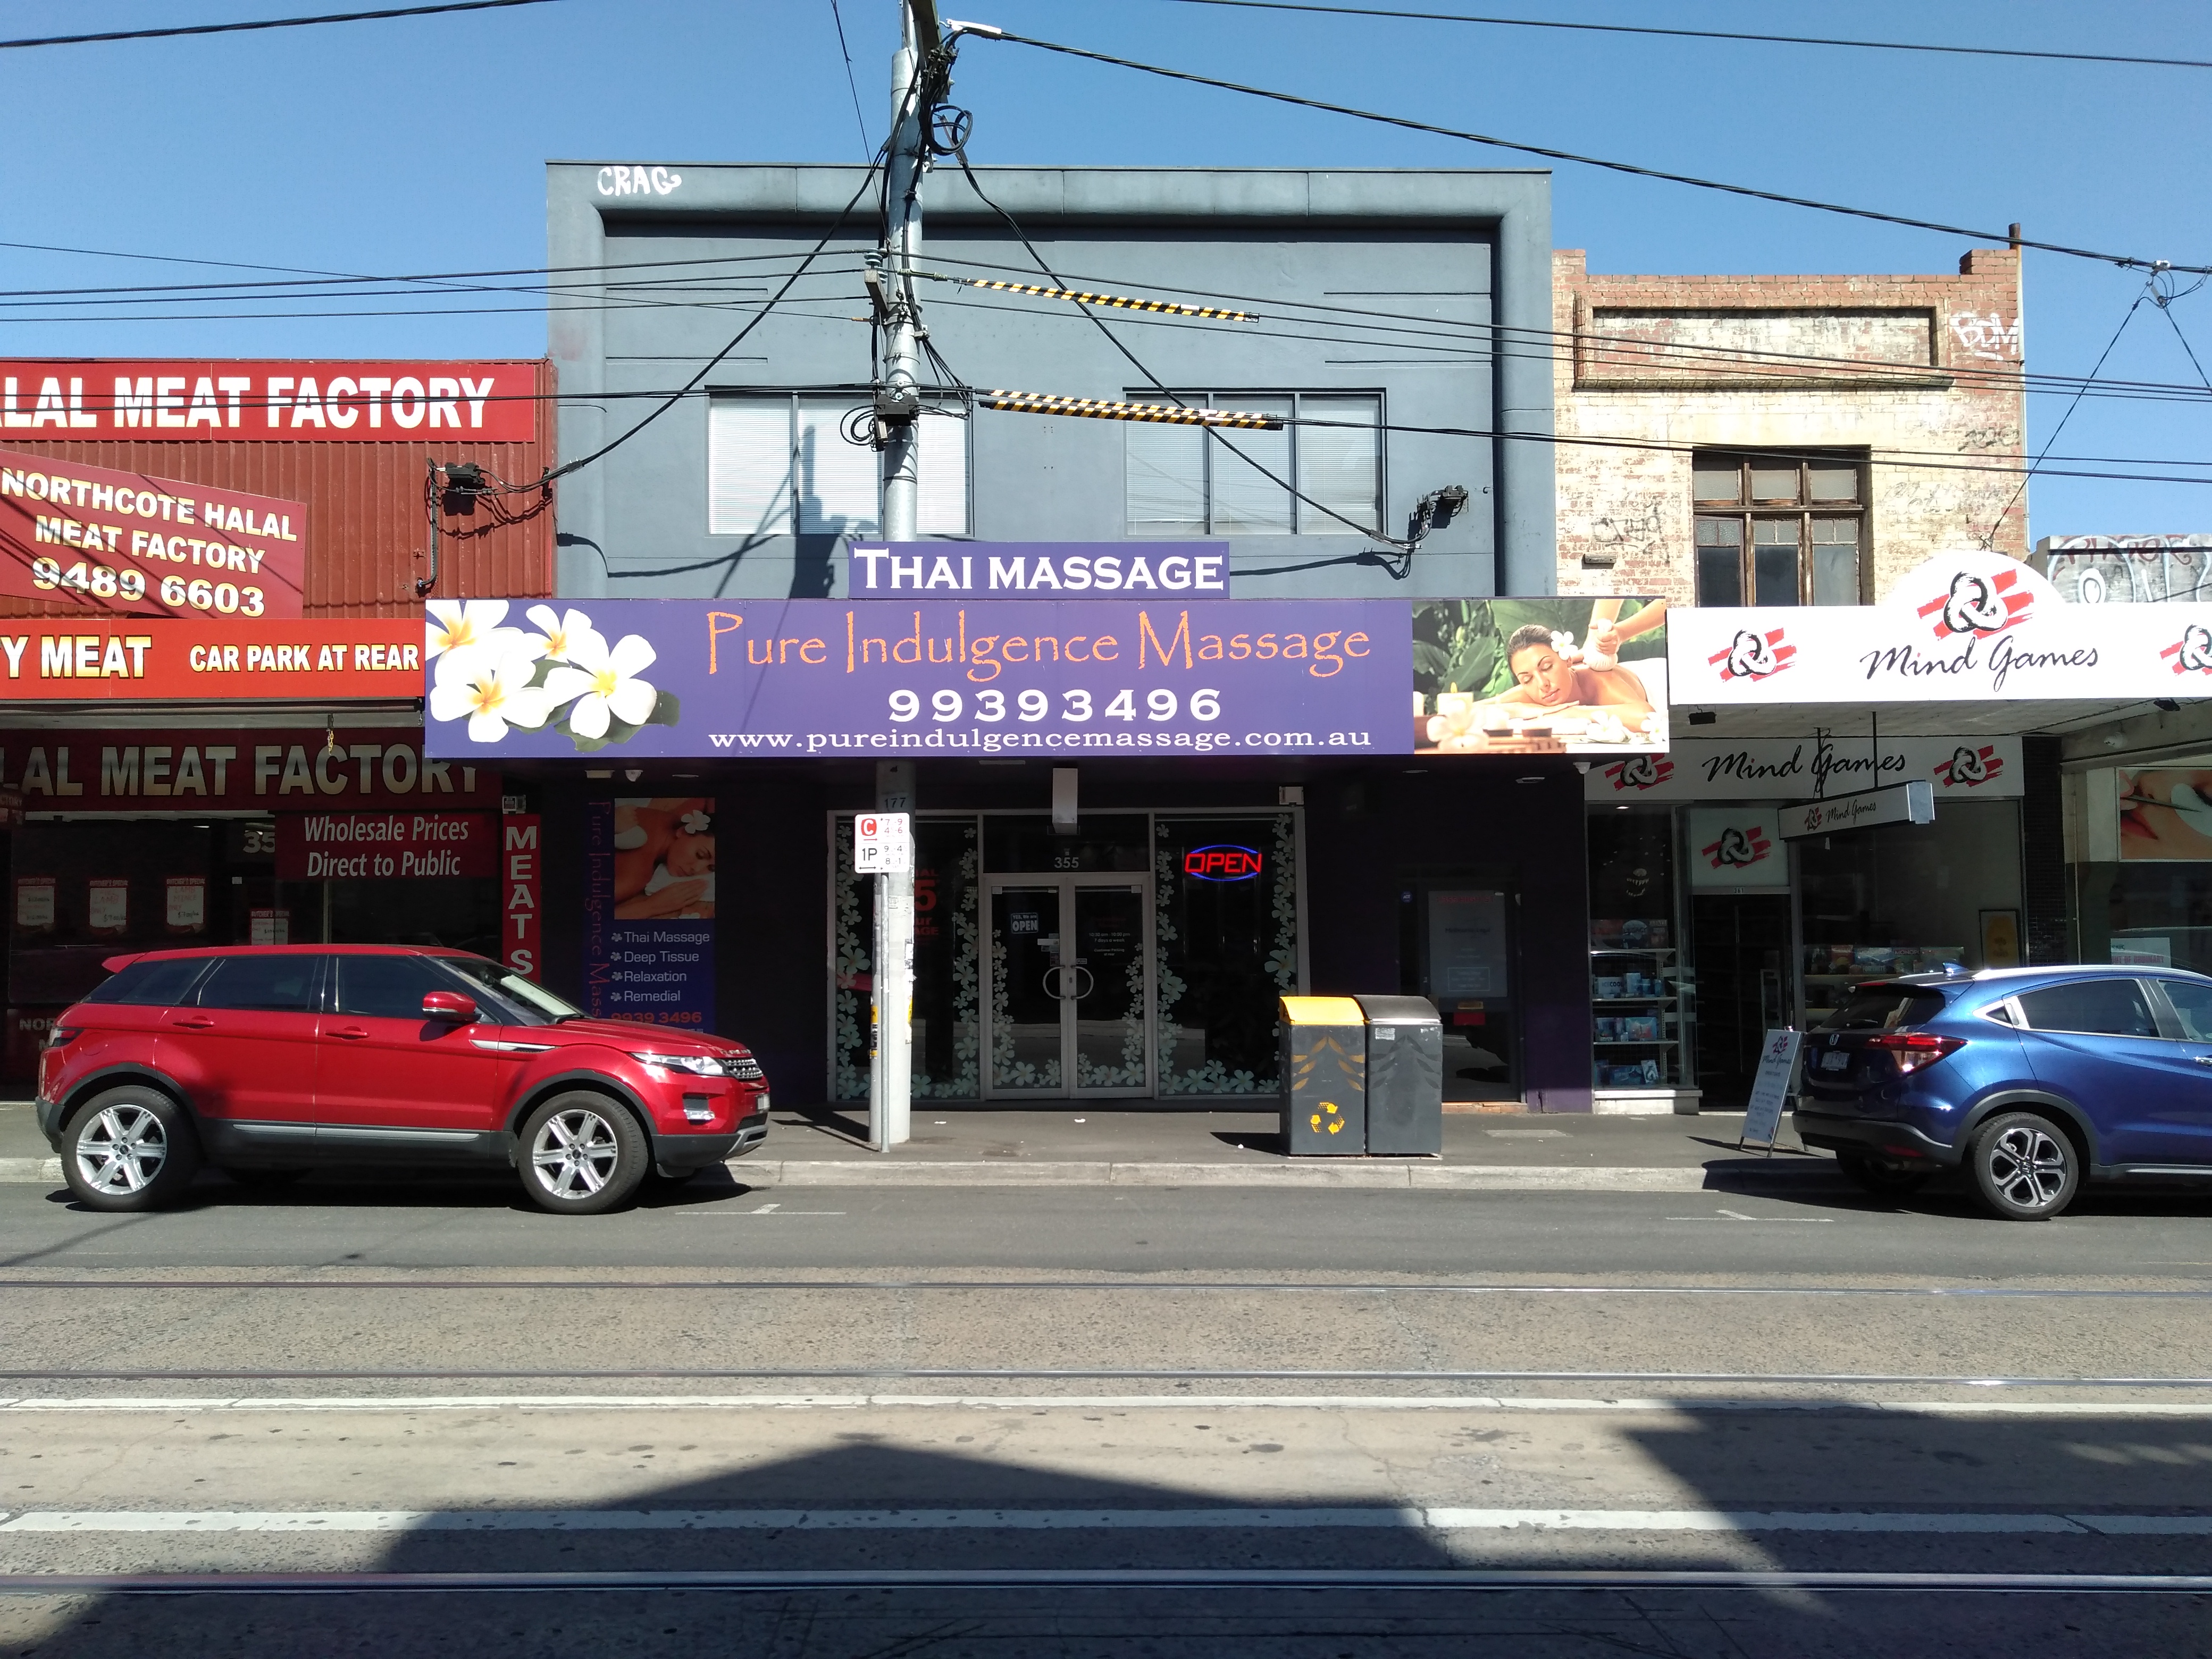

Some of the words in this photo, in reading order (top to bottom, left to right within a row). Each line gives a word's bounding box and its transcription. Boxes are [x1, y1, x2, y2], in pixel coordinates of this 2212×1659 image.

[114, 376, 250, 428] MEAT
[267, 376, 495, 429] FACTORY
[2, 467, 195, 525] NORTHCOTE
[205, 502, 297, 542] HALAL
[36, 514, 123, 553] MEAT
[132, 531, 265, 574] FACTORY
[854, 547, 974, 590] THAI
[987, 555, 1224, 590] MASSAGE
[32, 557, 146, 601] 9489
[161, 576, 265, 617] 6603
[41, 636, 152, 678] MEAT
[190, 645, 240, 672] CAR
[247, 645, 312, 672] PARK
[317, 644, 348, 671] AT
[355, 644, 420, 671] REAR
[708, 611, 826, 674] Pure
[847, 610, 1118, 682] Indulgence
[1138, 610, 1370, 677] Massage
[1860, 636, 1976, 680] Mind
[1989, 635, 2098, 692] Games
[889, 689, 1221, 722] 99393496
[708, 728, 1371, 752] www.pureindulgencemassage.com.au
[100, 746, 237, 796] MEAT
[1701, 744, 1804, 782] Mind
[1811, 743, 1906, 793] Games
[588, 802, 611, 846] Pure
[1825, 801, 1850, 823] Mind
[1851, 799, 1876, 825] Games
[305, 816, 405, 841] Wholesale
[412, 814, 468, 841] Prices
[307, 851, 367, 877] Direct
[374, 854, 394, 876] to
[402, 850, 460, 876] Public
[862, 848, 877, 861] 1P
[1054, 857, 1079, 869] 355
[1185, 853, 1262, 873] OPEN
[585, 852, 611, 956] Indulgence
[624, 931, 649, 943] Thai
[653, 931, 710, 945] Massage
[1012, 920, 1037, 932] OPEN
[624, 951, 656, 965] Deep
[659, 951, 700, 962] Tissue
[624, 970, 687, 982] Relaxation
[624, 990, 681, 1002] Remedial
[658, 1011, 702, 1023] 3496
